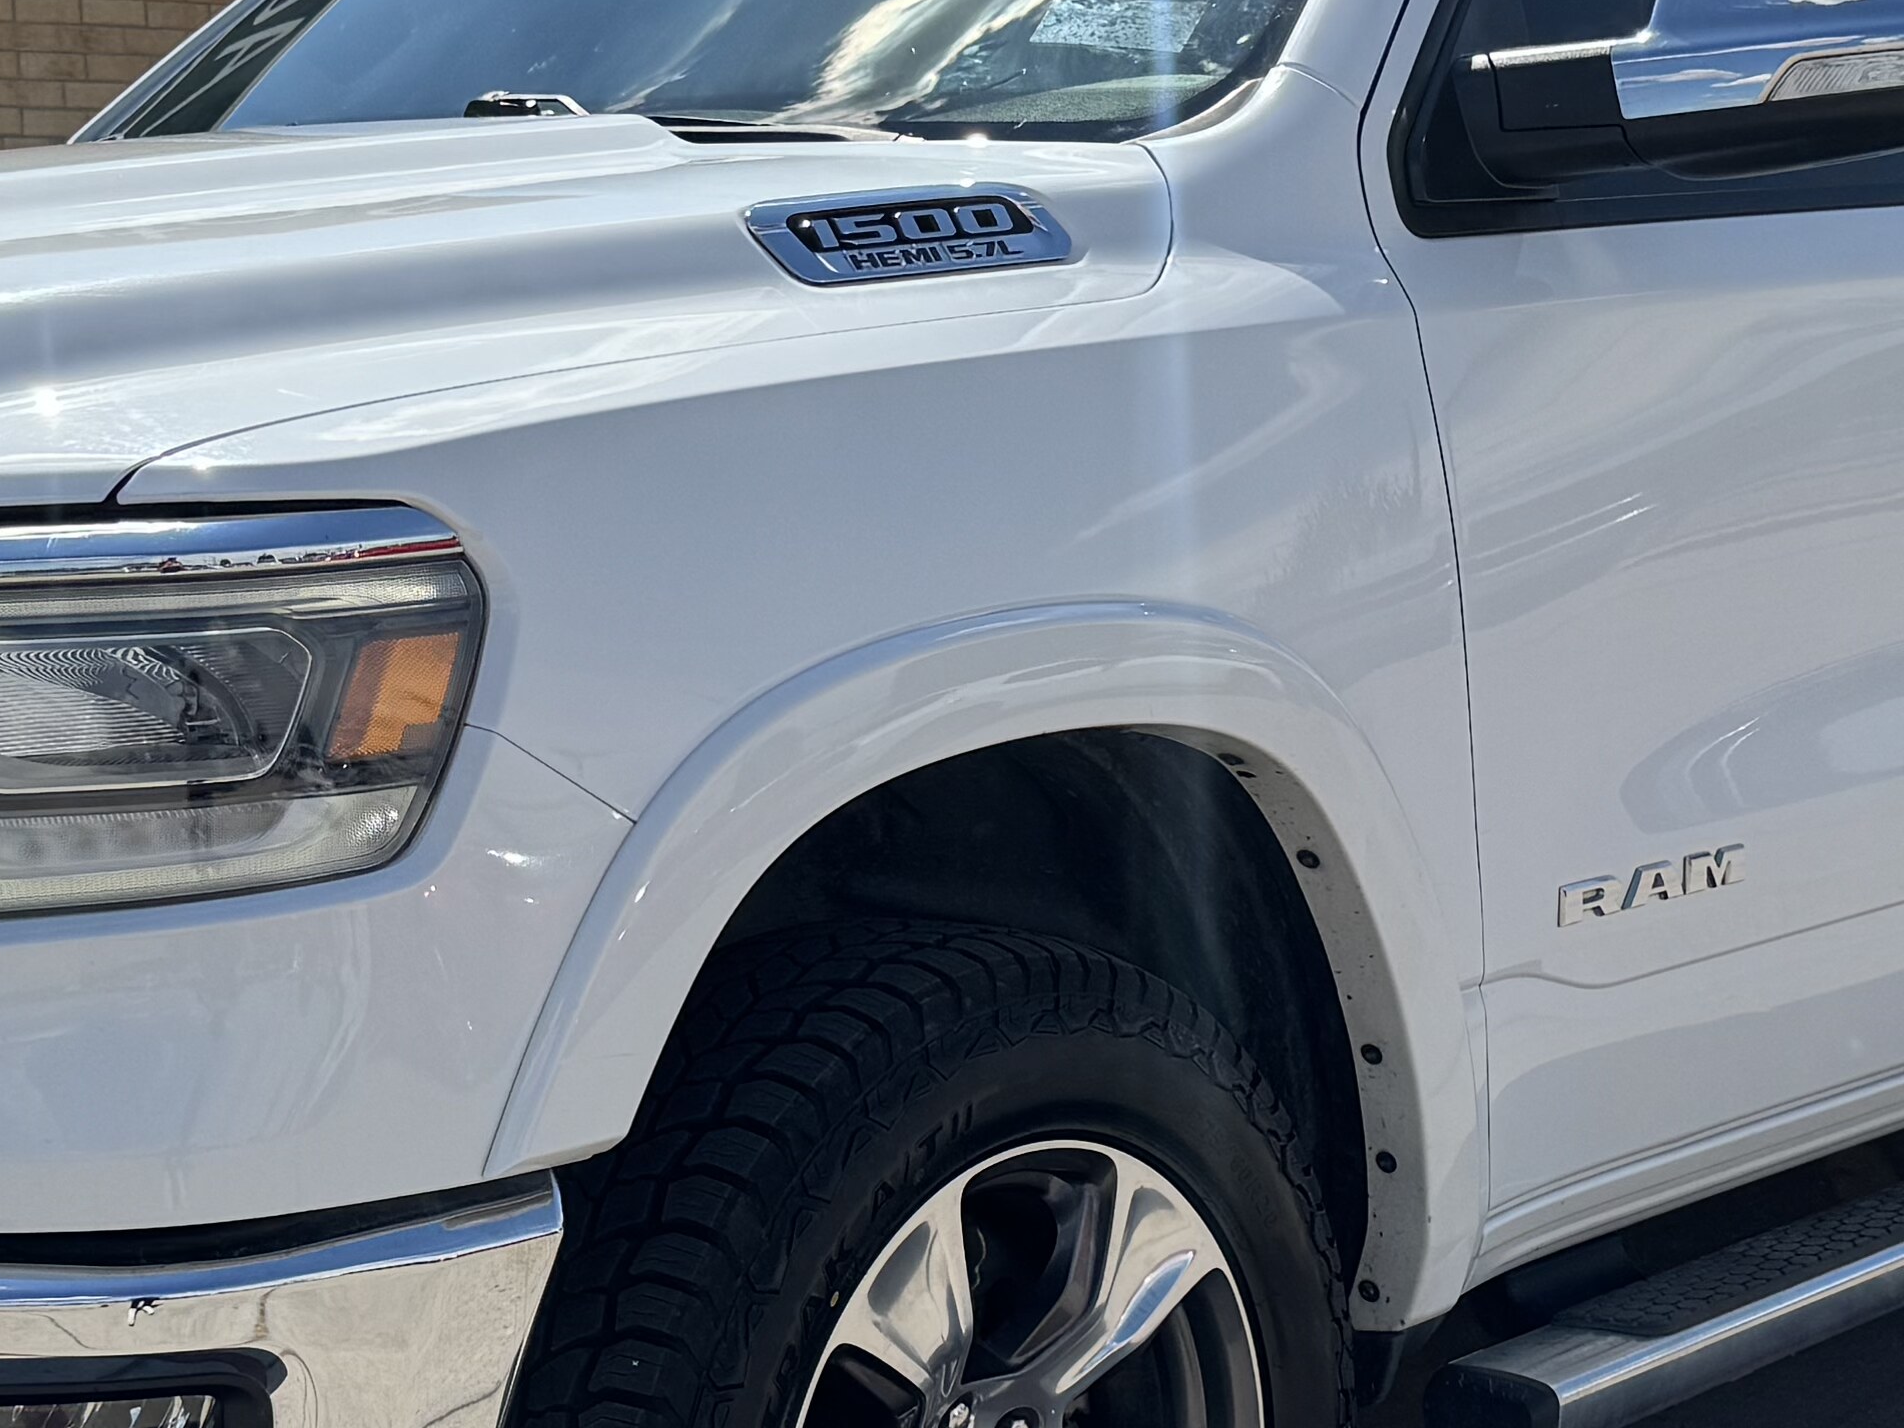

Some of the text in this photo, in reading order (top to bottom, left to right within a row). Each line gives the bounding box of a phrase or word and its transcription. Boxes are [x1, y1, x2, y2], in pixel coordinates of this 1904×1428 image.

[814, 203, 1014, 248] 1500
[846, 239, 1024, 272] HEMI 5.7L
[1557, 842, 1745, 928] RAM
